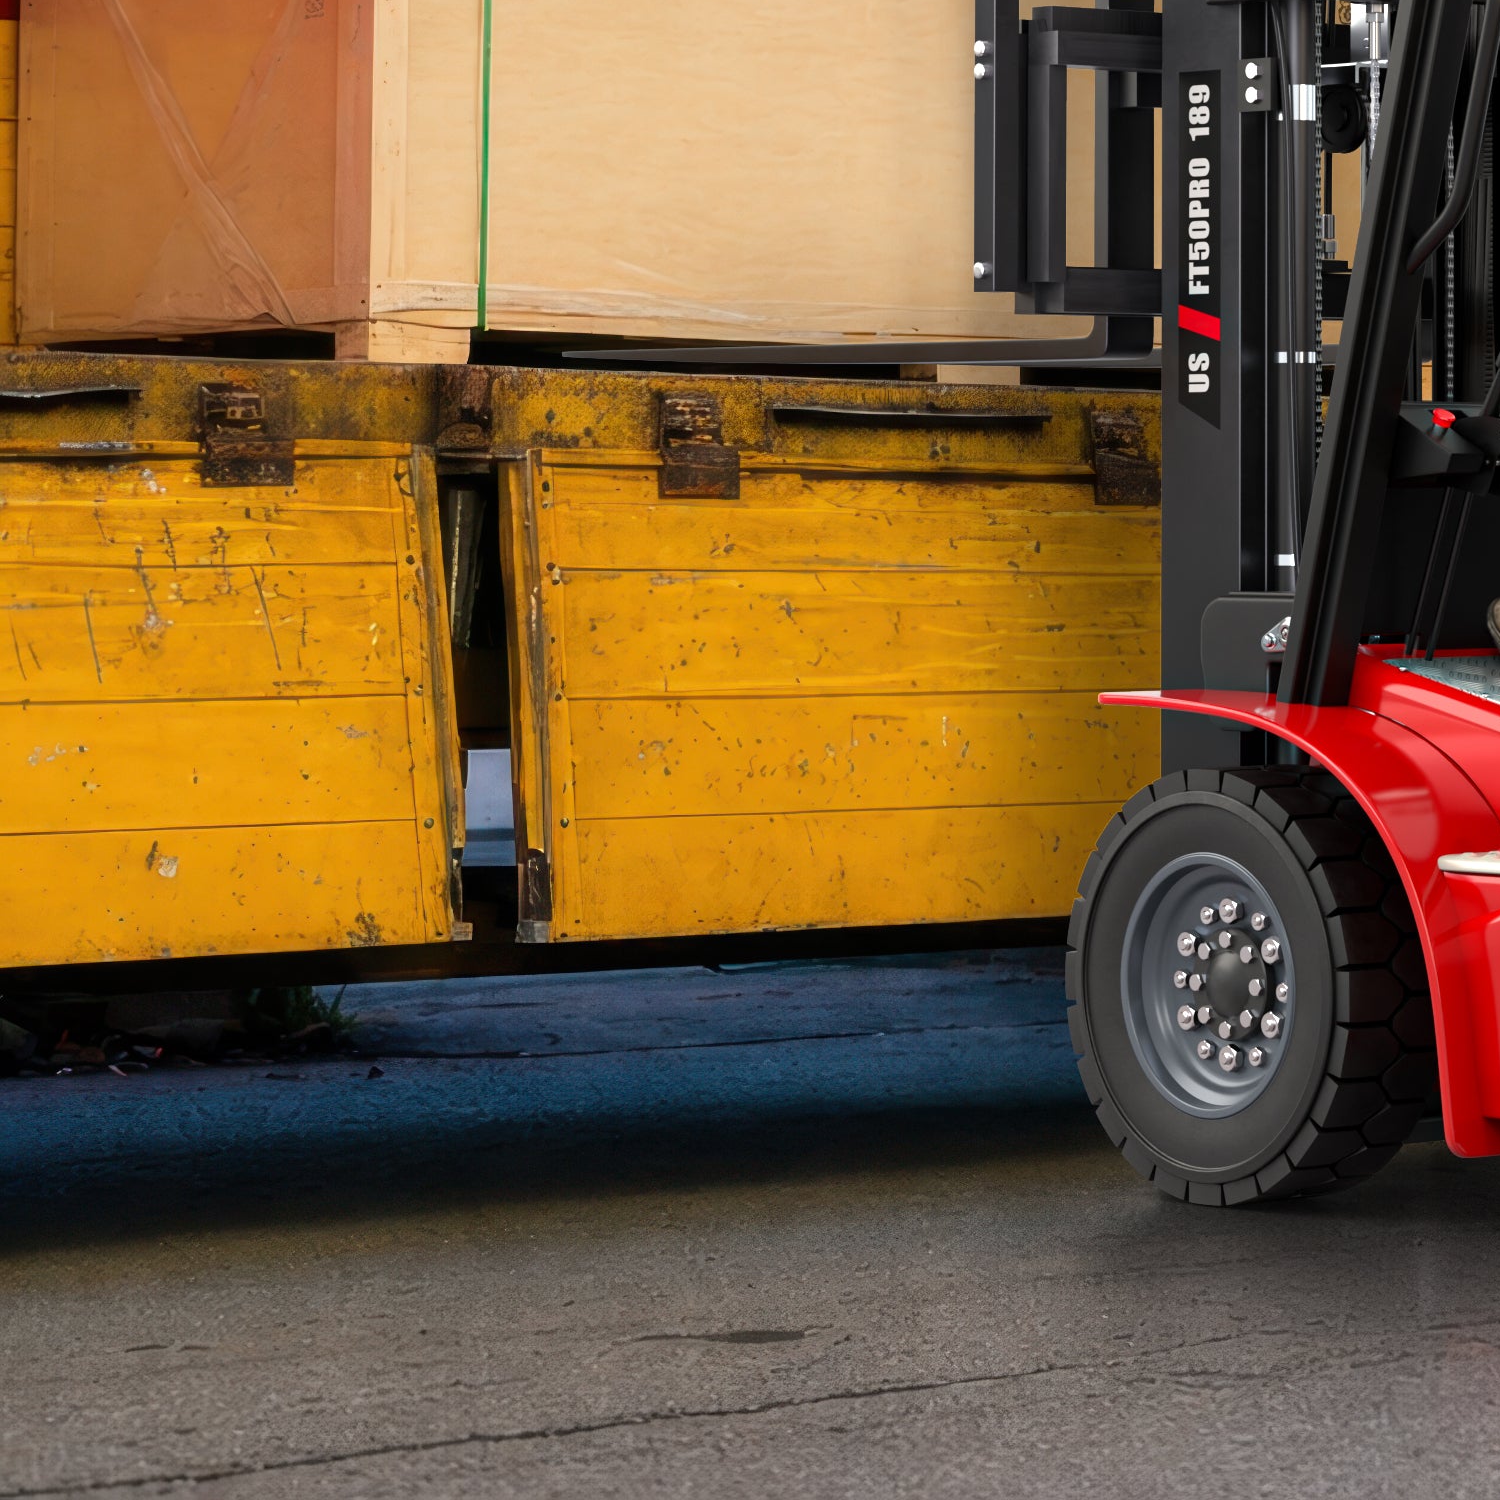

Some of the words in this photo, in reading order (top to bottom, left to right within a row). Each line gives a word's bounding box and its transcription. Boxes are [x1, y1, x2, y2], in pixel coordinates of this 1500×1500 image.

[1187, 83, 1211, 142] 189
[1187, 157, 1211, 296] FT50PRO
[1188, 352, 1210, 394] US
